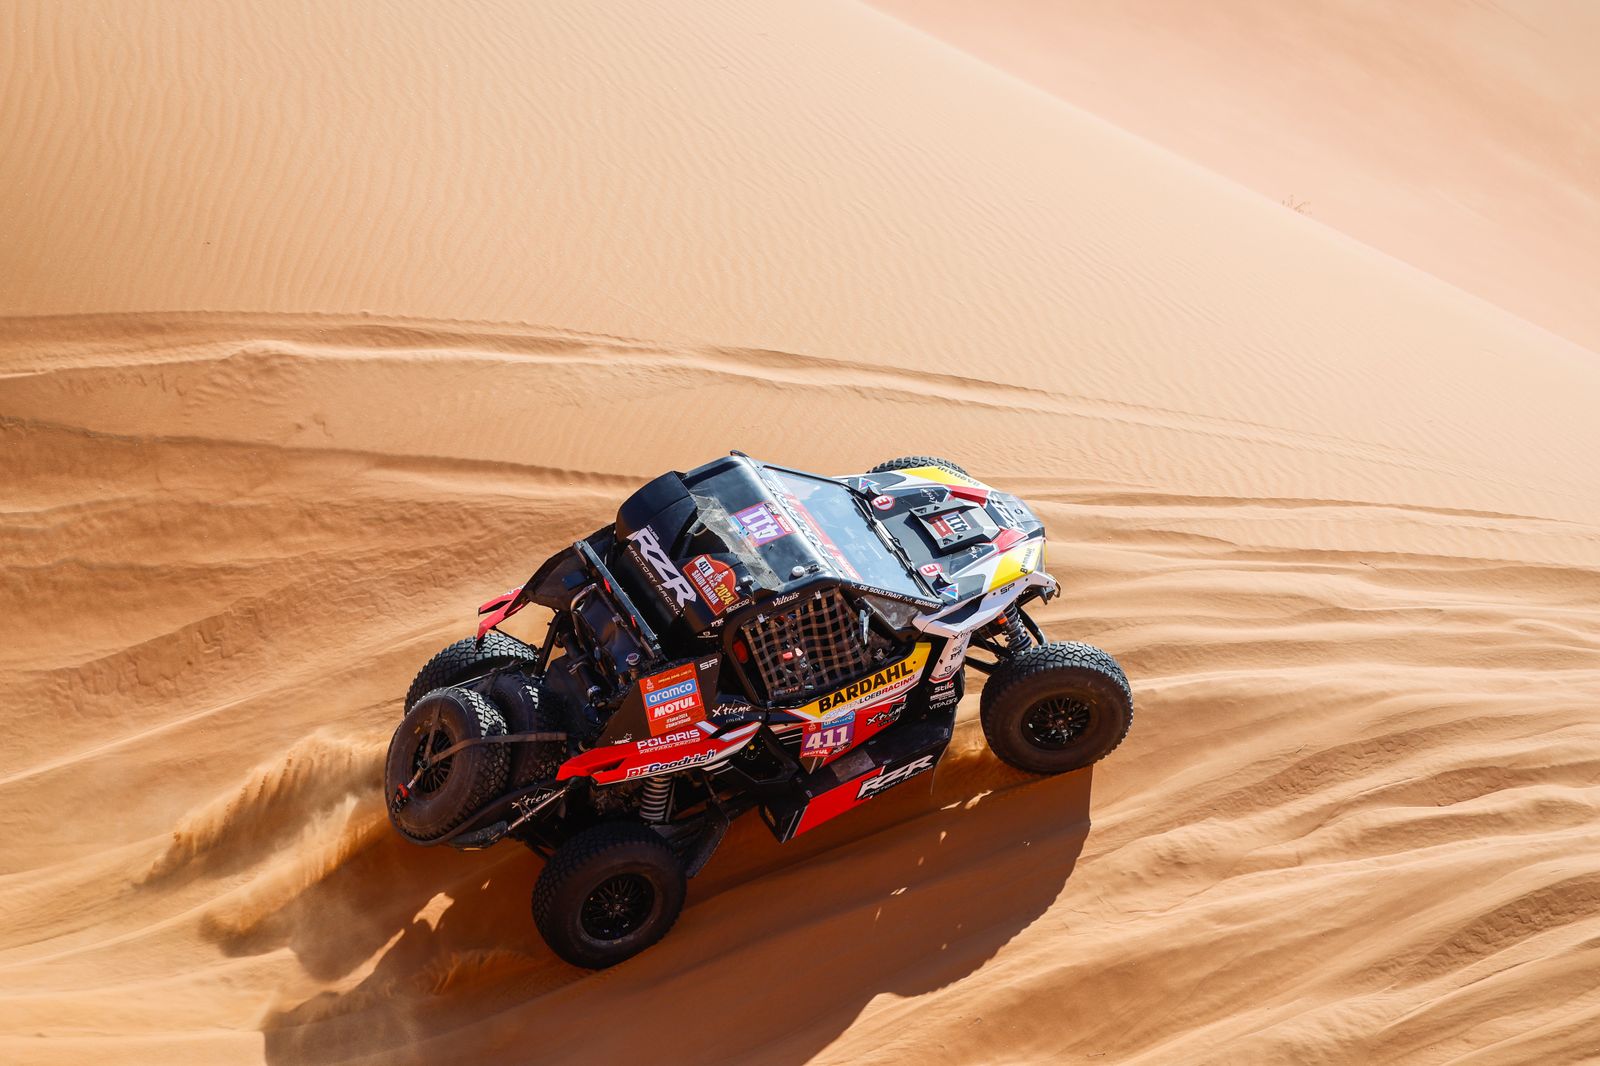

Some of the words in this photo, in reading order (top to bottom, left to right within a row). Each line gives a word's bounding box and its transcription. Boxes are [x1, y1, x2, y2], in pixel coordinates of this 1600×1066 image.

[739, 506, 779, 540] 411
[945, 512, 969, 533] 411
[626, 527, 697, 609] RZR
[627, 544, 658, 584] FACTORY
[691, 569, 707, 588] SAUDI
[701, 583, 720, 606] ARABIA
[698, 560, 712, 575] 411
[713, 583, 735, 606] 2024
[1000, 582, 1016, 595] SP
[868, 586, 903, 600] SOULTRAIT
[914, 599, 942, 610] BONNET
[699, 658, 719, 671] SP
[649, 682, 694, 704] aramco
[818, 661, 914, 713] BARDAHL
[653, 696, 696, 718] MOTUL
[636, 728, 700, 750] POLARIS
[805, 726, 850, 750] 411
[626, 749, 718, 778] BFGoodrich
[857, 754, 934, 798] RZR
